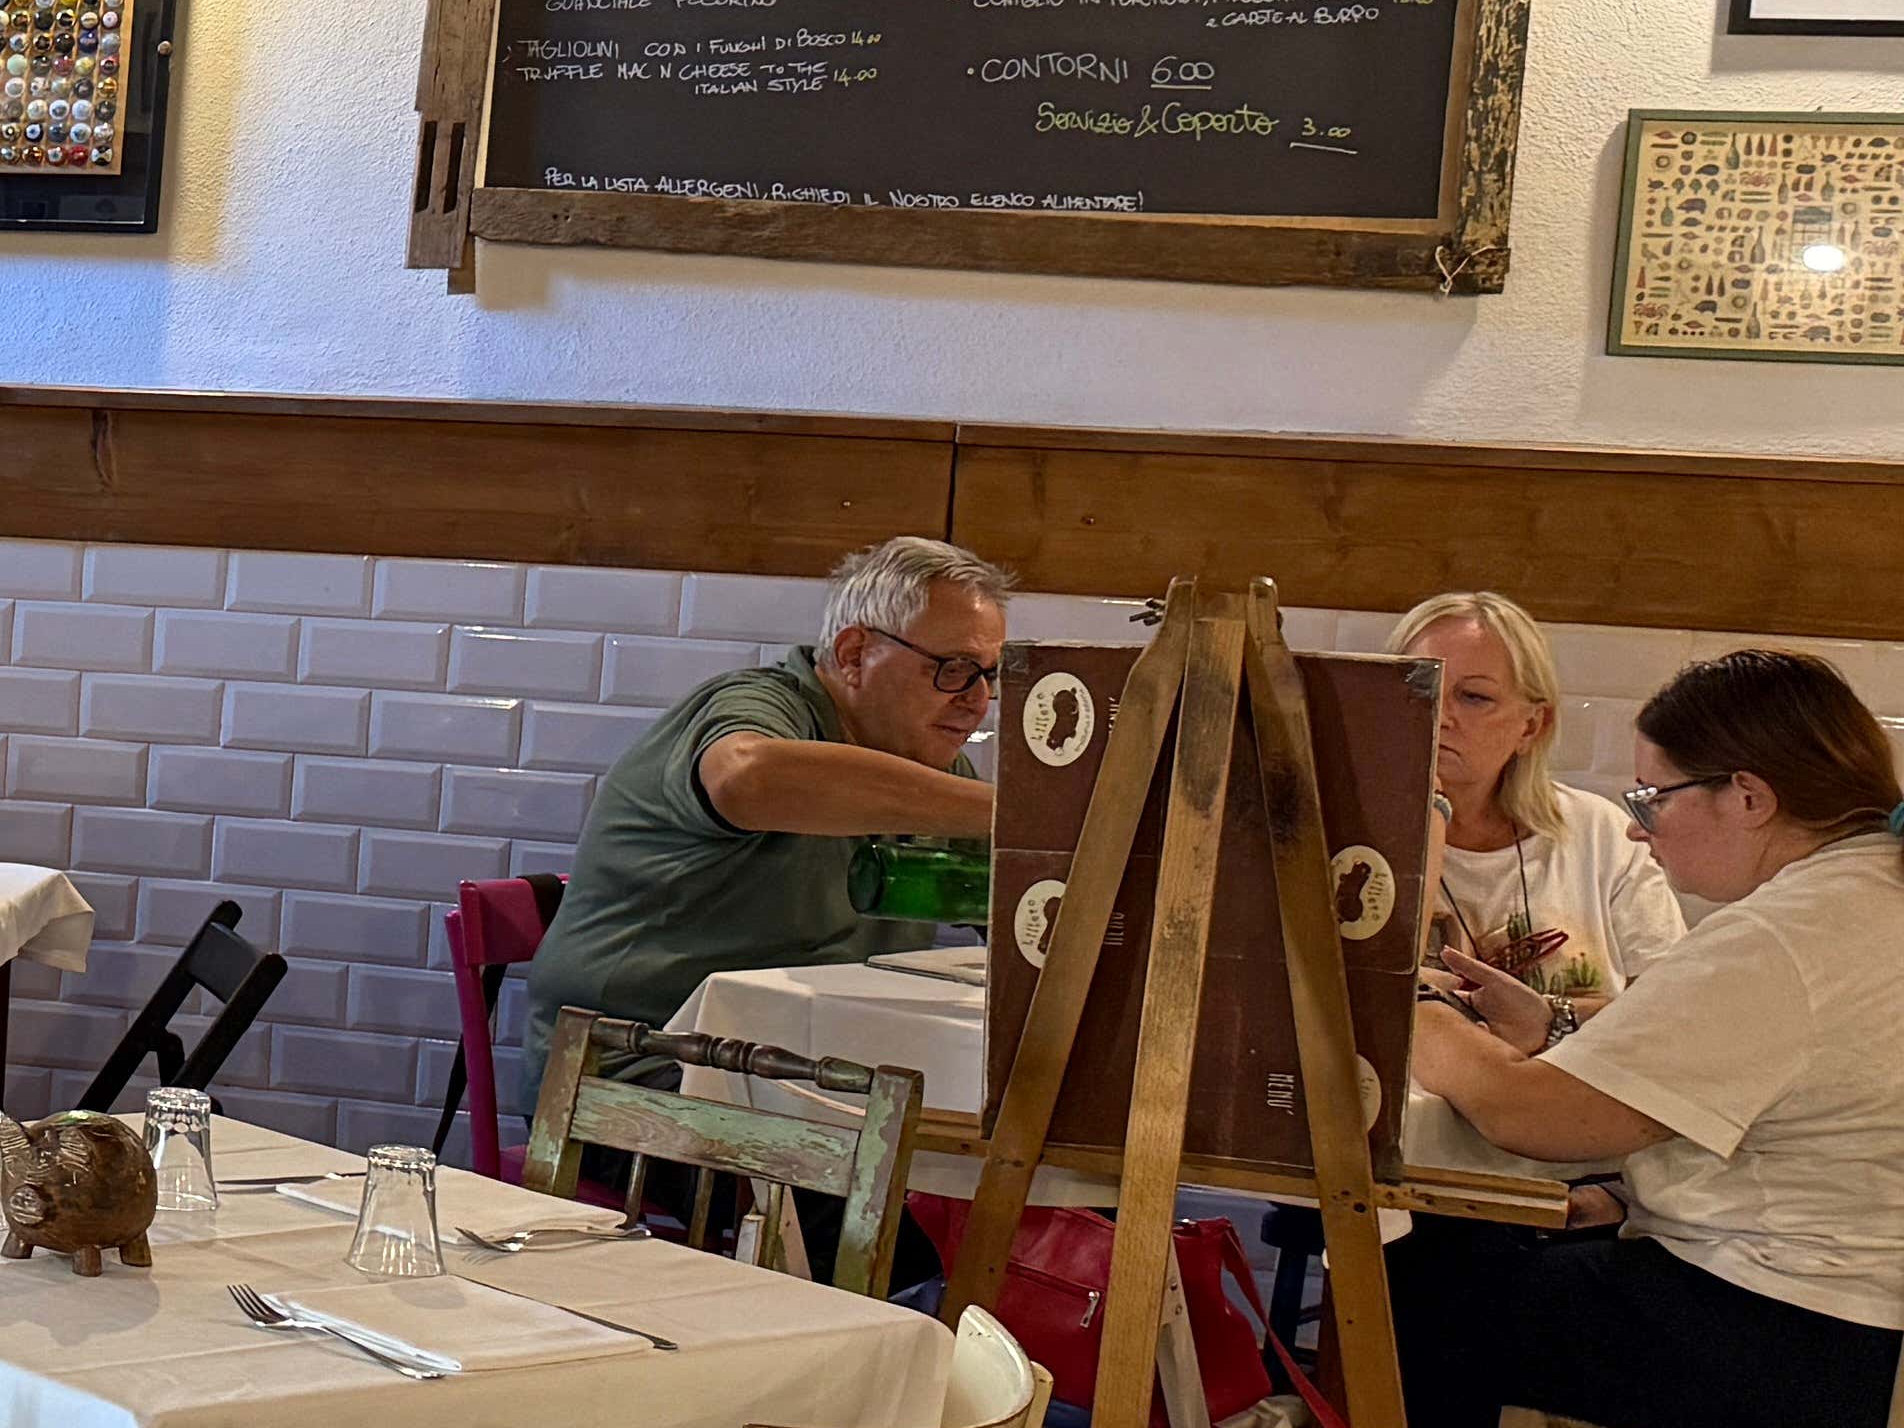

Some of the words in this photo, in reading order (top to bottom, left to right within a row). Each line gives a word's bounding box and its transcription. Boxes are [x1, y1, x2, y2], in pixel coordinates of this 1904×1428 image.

[1313, 5, 1380, 24] BURRO
[644, 42, 686, 57] CON
[710, 35, 766, 54] FUNGHI
[797, 28, 847, 48] BOSCO
[516, 63, 603, 82] TRUFFLE
[618, 63, 654, 80] MAC
[679, 62, 752, 81] CHEESE
[981, 51, 1130, 85] CONTORNI
[1151, 55, 1215, 84] 6.00
[695, 77, 759, 95] ITALIAN
[766, 76, 824, 93] STYLE
[1035, 101, 1134, 135] Servizio
[1302, 117, 1352, 138] 3.00
[544, 166, 575, 188] PER
[604, 176, 649, 193] LISTA
[890, 189, 960, 209] NOSTRO
[969, 193, 1035, 209] ELENCO
